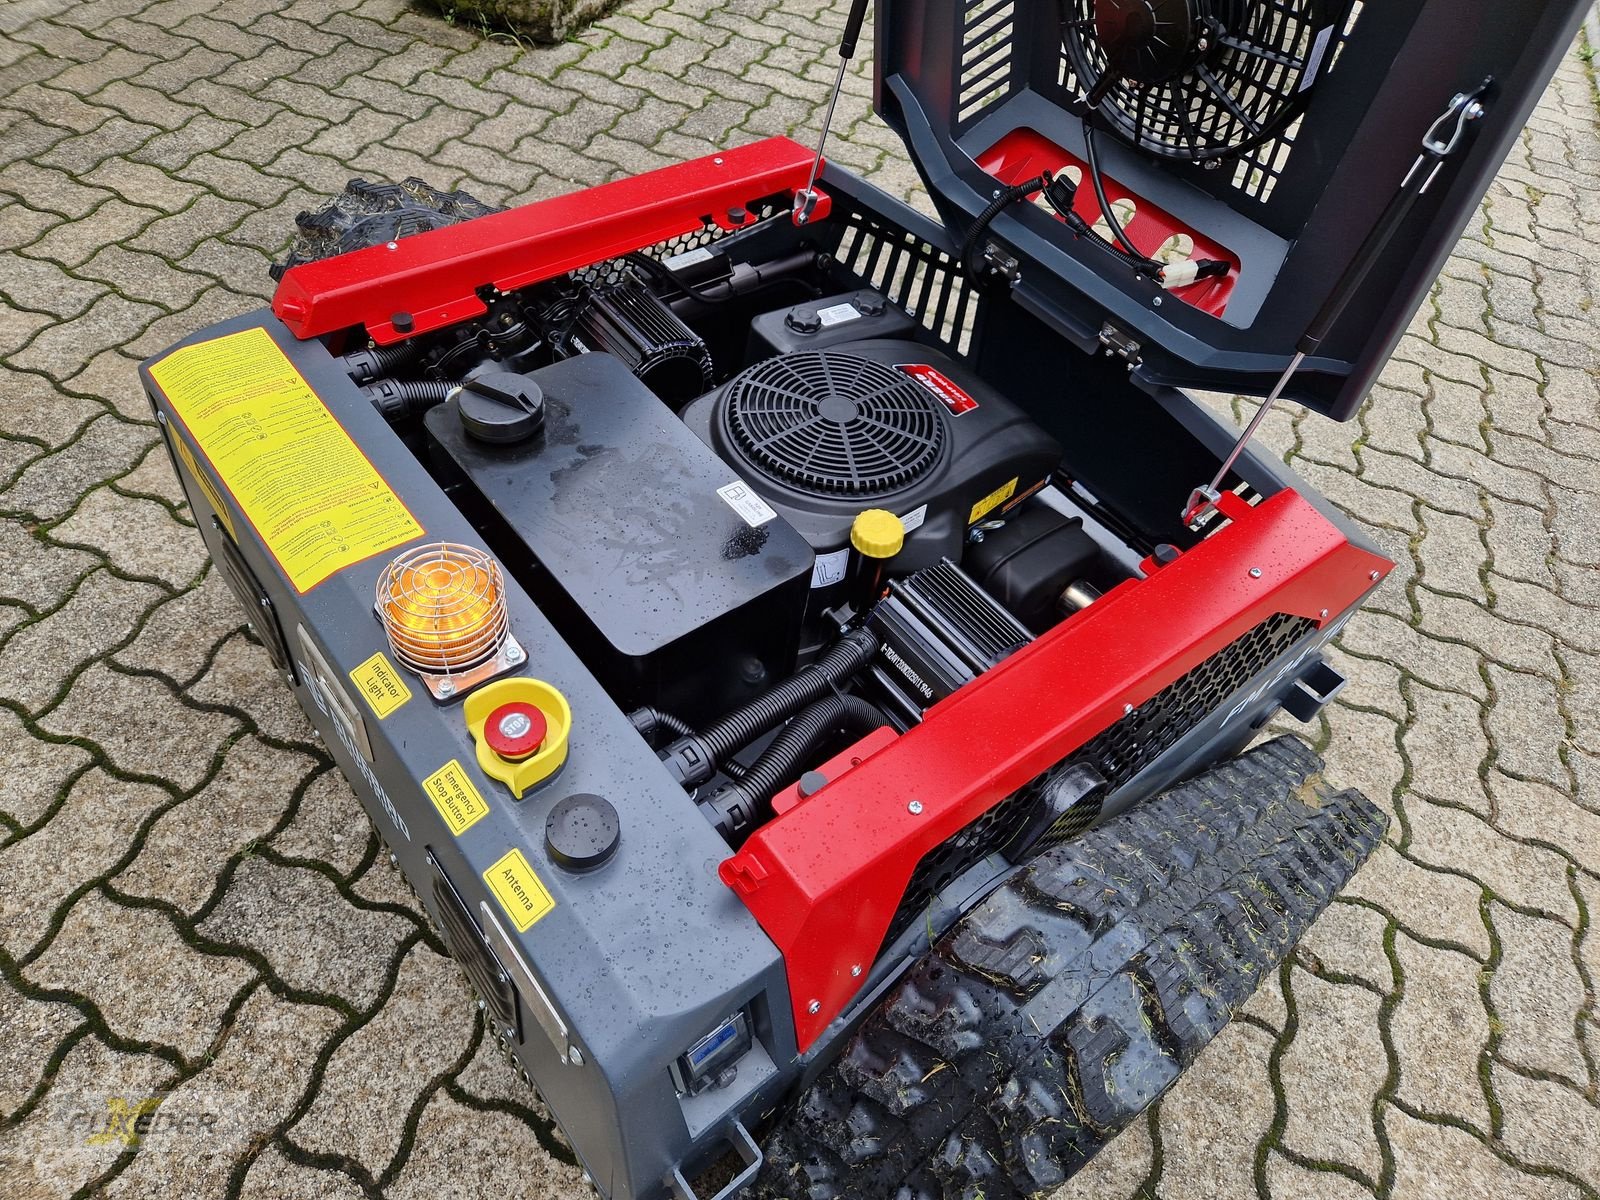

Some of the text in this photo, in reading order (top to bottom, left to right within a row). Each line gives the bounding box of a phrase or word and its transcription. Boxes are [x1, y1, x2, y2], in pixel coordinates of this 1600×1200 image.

[366, 677, 386, 700] Light
[371, 661, 401, 699] Indicator
[504, 717, 526, 735] STOP
[432, 777, 467, 826] Stop Button
[444, 770, 477, 816] Emergency
[501, 868, 534, 912] Antenna
